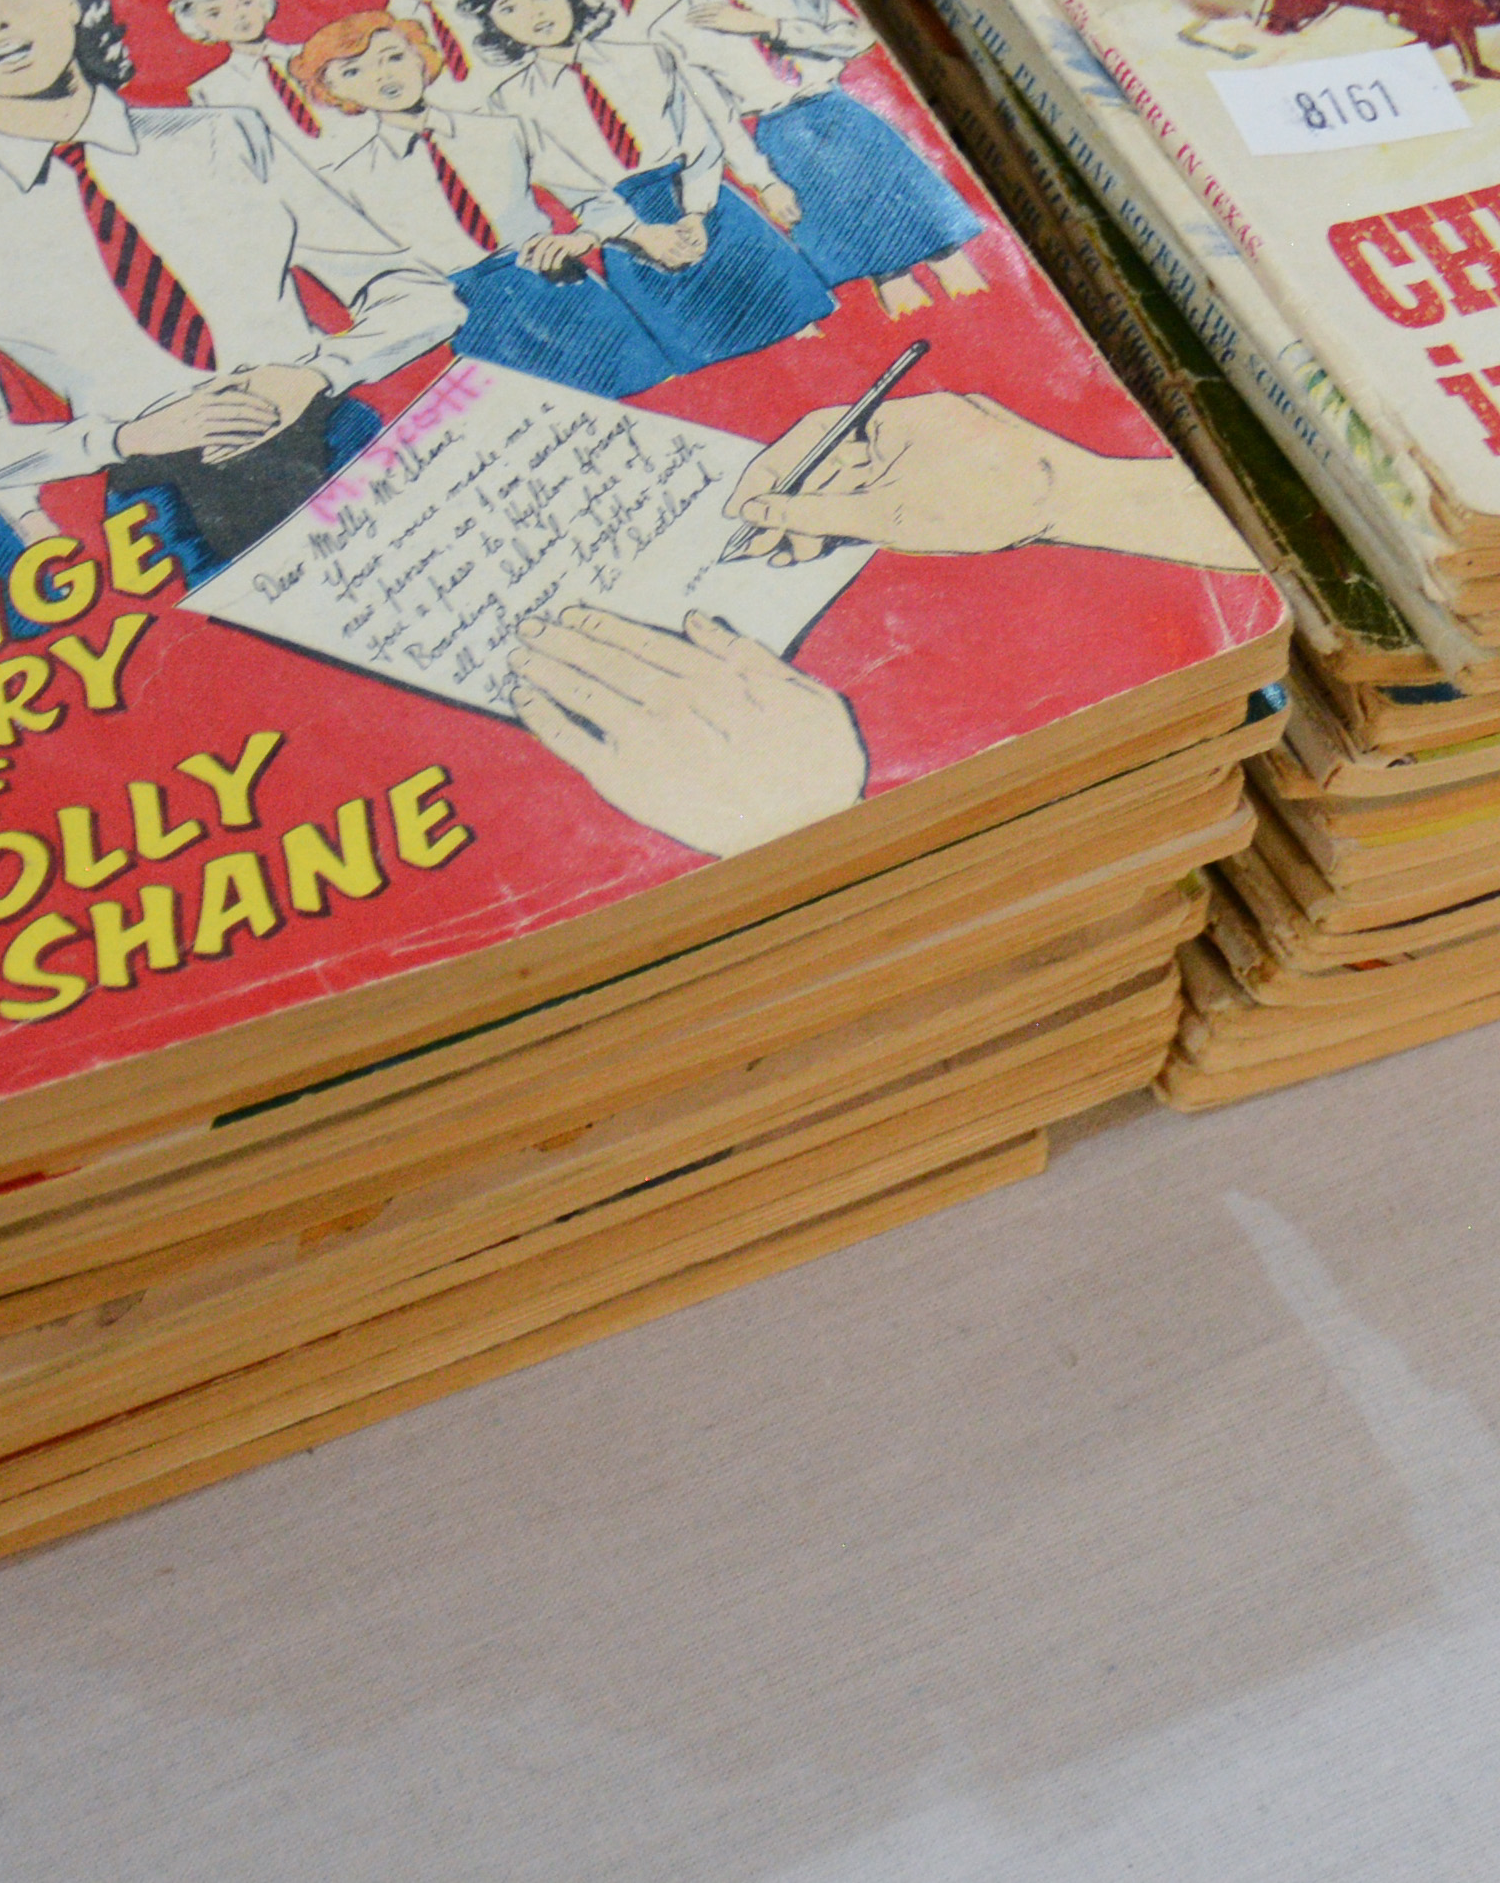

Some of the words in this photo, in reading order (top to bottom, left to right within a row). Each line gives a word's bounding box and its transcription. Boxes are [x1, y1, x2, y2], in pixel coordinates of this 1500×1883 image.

[1170, 141, 1205, 177] IN
[1300, 79, 1400, 131] 8161
[1007, 61, 1068, 132] PLAN
[1059, 129, 1119, 199] THAT
[1112, 195, 1200, 301] ROCKED
[1192, 297, 1242, 353] THE
[253, 560, 306, 604] Dear
[309, 504, 377, 560] Molly
[322, 553, 384, 602] Your
[389, 504, 440, 549] voice
[445, 449, 501, 501] made
[503, 416, 534, 450] me
[341, 604, 376, 638] new
[453, 517, 478, 540] so
[498, 473, 524, 499] am
[529, 411, 599, 471] sending
[367, 620, 410, 664] you
[435, 560, 475, 605] pass
[480, 533, 504, 557] to
[503, 474, 574, 531] Hylton
[404, 590, 508, 671] Boarding
[499, 522, 569, 589] School
[624, 450, 656, 477] of
[453, 647, 485, 684] all
[570, 486, 652, 571] together
[655, 432, 707, 486] with
